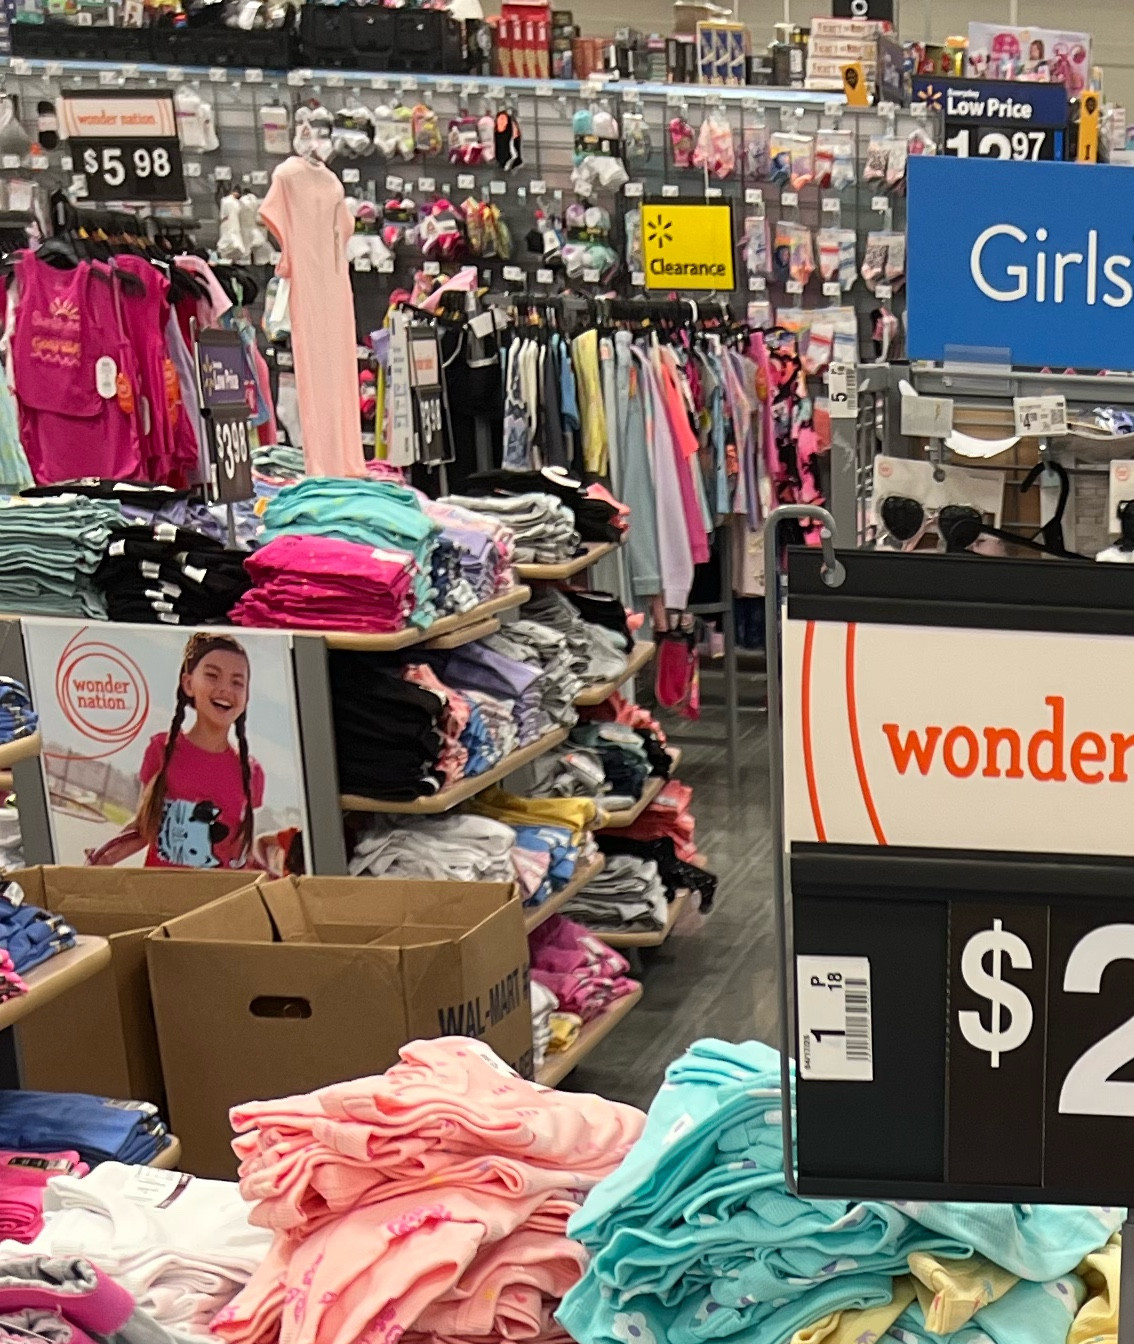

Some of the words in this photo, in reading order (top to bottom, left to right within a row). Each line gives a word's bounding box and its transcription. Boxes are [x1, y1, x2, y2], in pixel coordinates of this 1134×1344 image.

[947, 97, 986, 117] Low
[988, 98, 1032, 119] Price
[77, 109, 117, 126] wonder
[121, 112, 156, 126] nation
[650, 259, 727, 278] Clearance
[73, 673, 130, 693] wonder
[77, 694, 126, 710] nation
[811, 975, 826, 987] P
[827, 972, 843, 991] 18
[810, 1029, 846, 1043] 1
